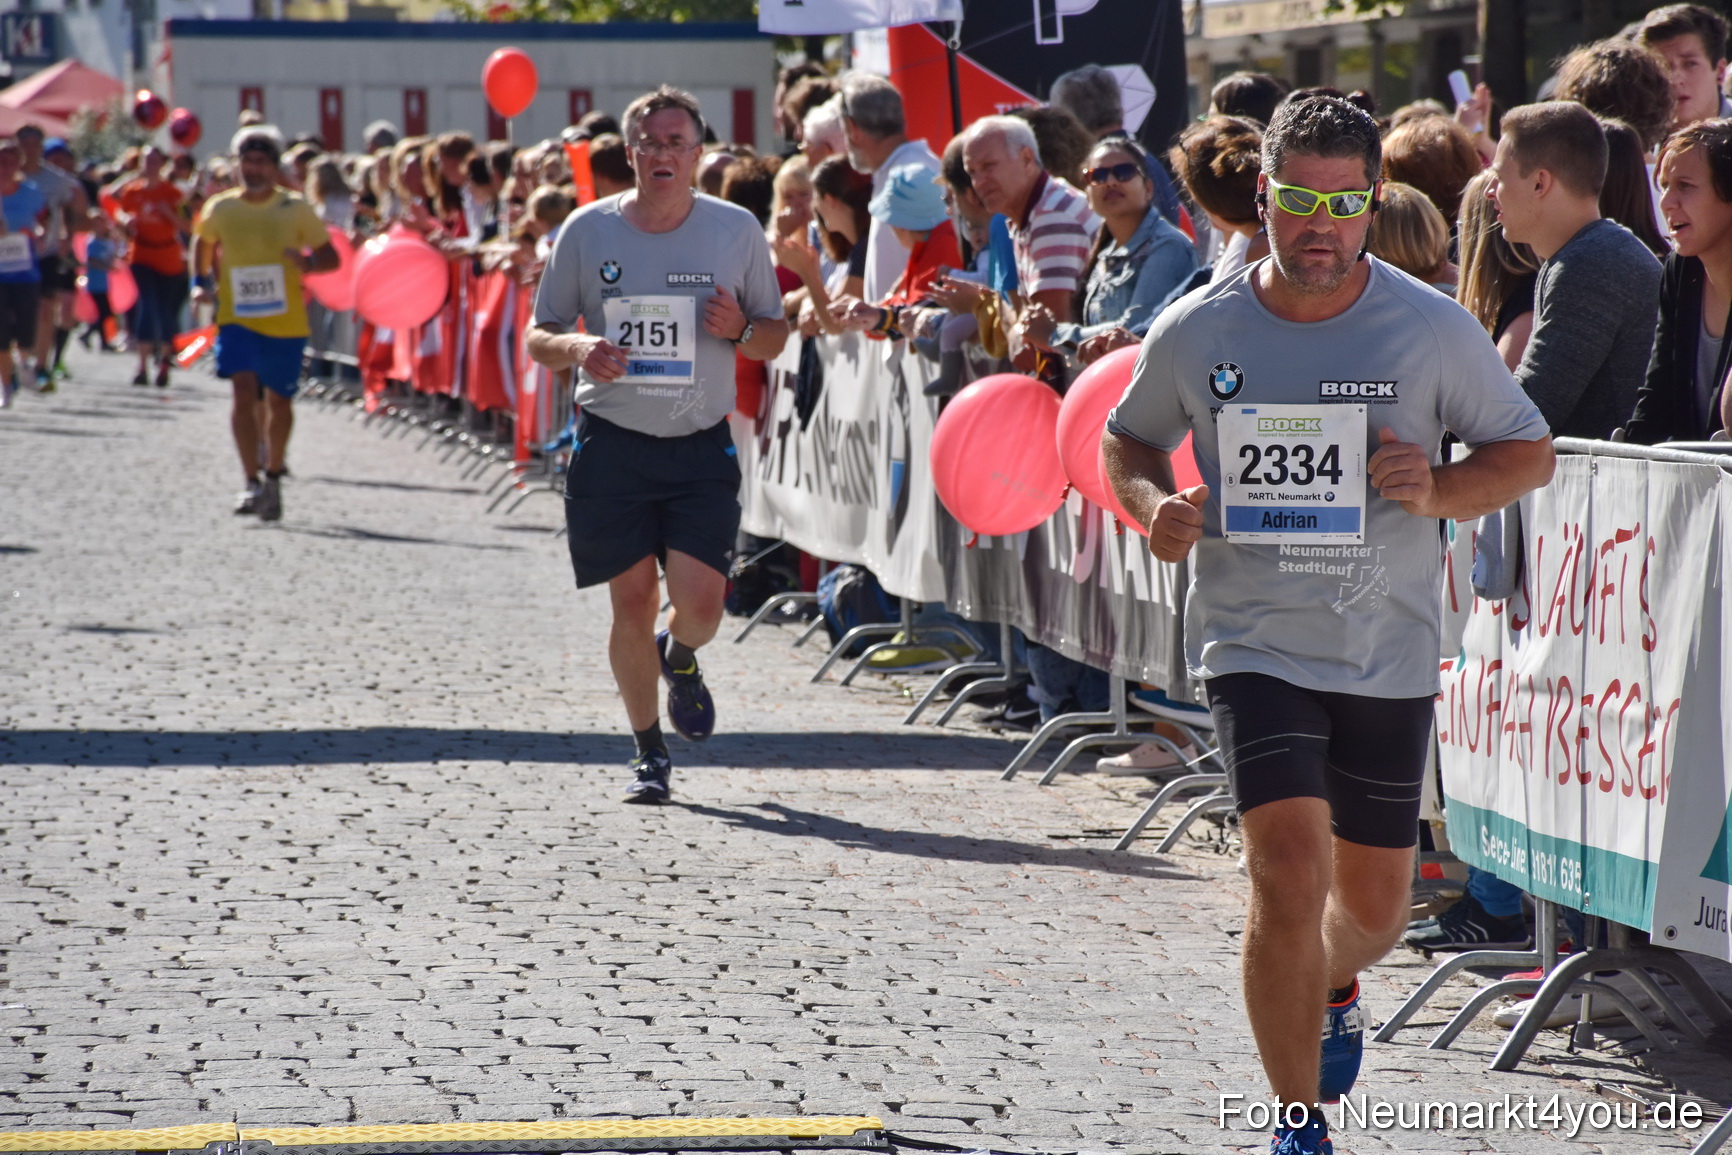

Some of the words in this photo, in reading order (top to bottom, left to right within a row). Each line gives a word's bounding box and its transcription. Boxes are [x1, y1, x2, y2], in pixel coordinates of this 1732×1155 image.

[667, 273, 713, 284] BOCK
[631, 304, 670, 315] BOCK
[618, 321, 678, 347] 2151
[633, 362, 665, 374] Erwin
[1211, 363, 1242, 376] BMW
[636, 386, 684, 399] Stadtlauf
[1320, 382, 1397, 397] BOCK
[1258, 418, 1322, 432] BOCK
[1239, 444, 1343, 486] 2334
[1248, 492, 1277, 501] PARTL
[1278, 492, 1321, 501] Neumarkt
[1261, 511, 1317, 529] Adrian
[1279, 544, 1373, 559] Neumarkter
[1278, 561, 1356, 579] Stadtlauf
[1343, 579, 1375, 608] September
